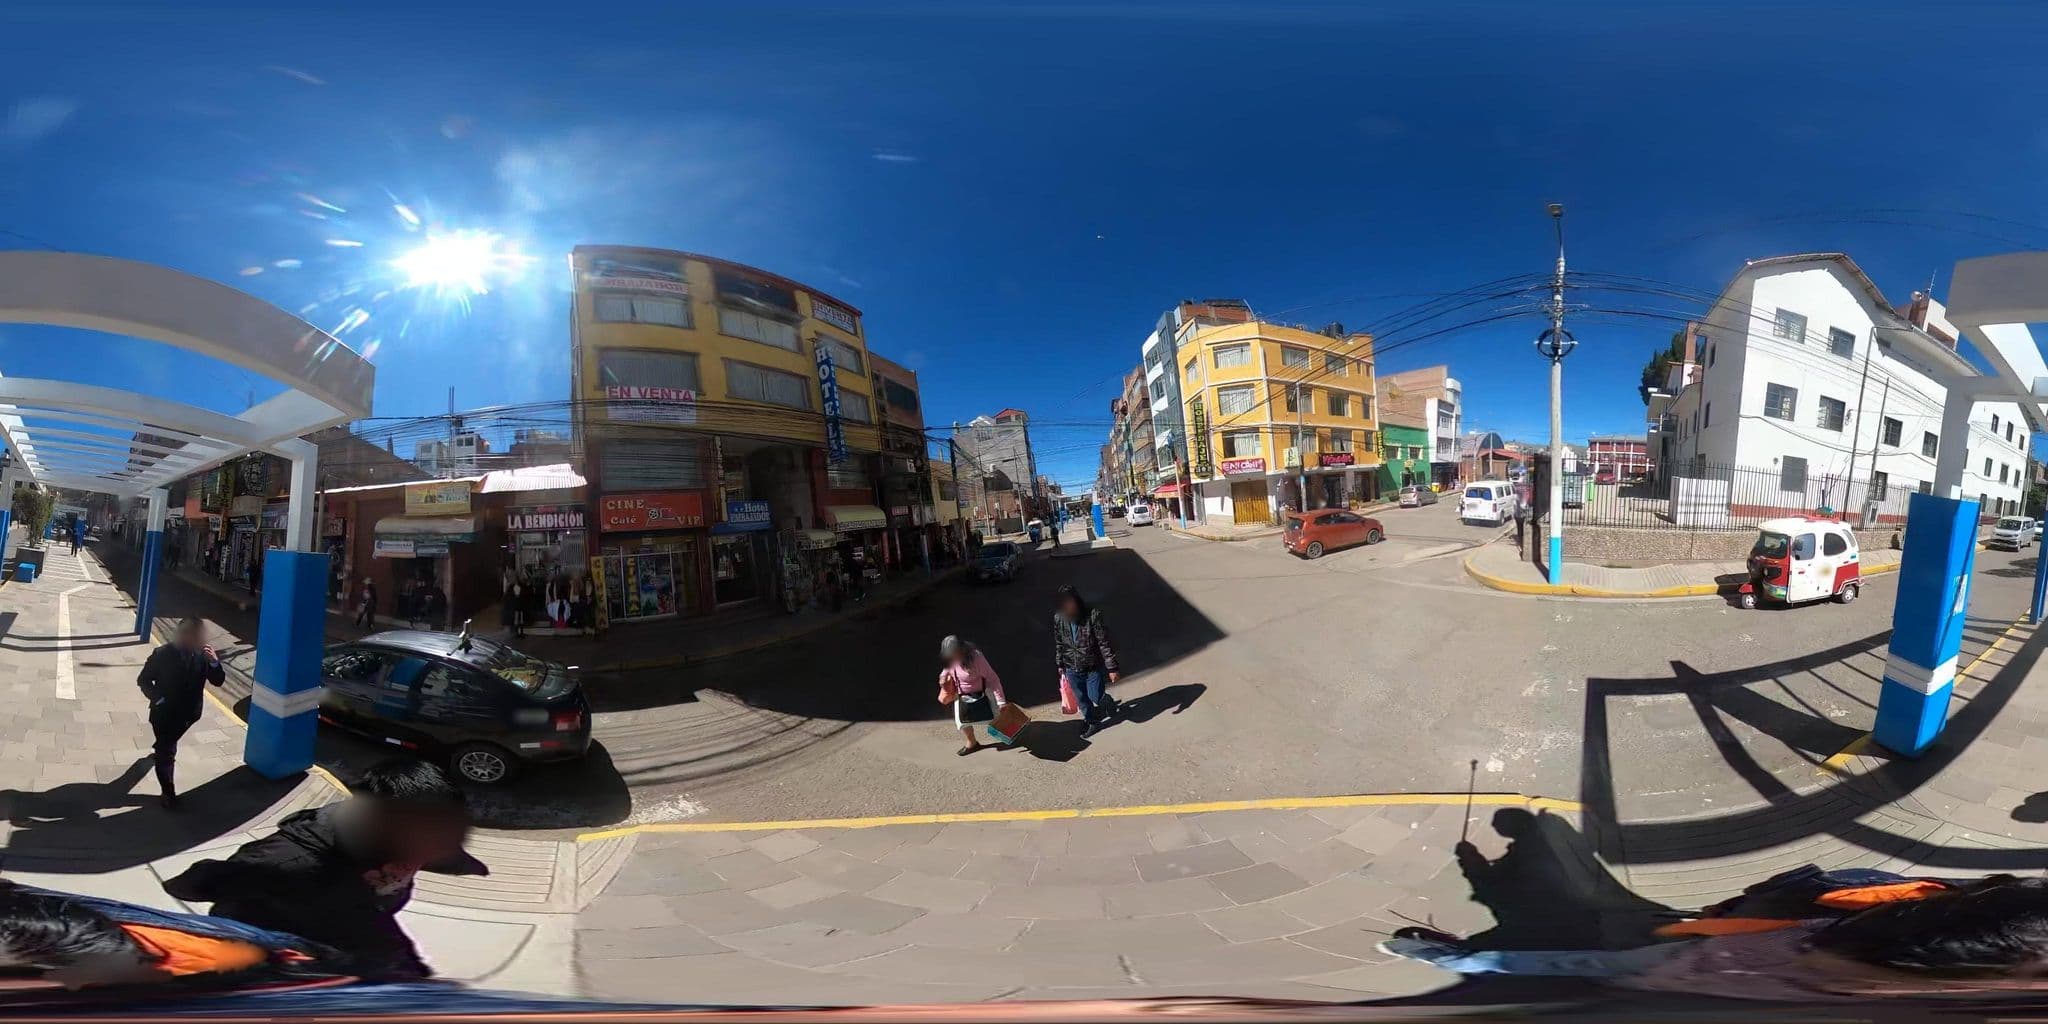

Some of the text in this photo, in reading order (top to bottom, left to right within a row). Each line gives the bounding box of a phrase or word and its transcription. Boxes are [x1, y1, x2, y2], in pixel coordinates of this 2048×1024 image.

[608, 385, 692, 401] EN VENTA
[816, 348, 837, 438] HOTEL
[1194, 403, 1207, 462] HOSPEDAJE
[606, 499, 643, 509] CINE
[744, 503, 768, 513] Hotel
[507, 510, 584, 529] LA BENDICIÓN
[676, 515, 700, 526] VIP
